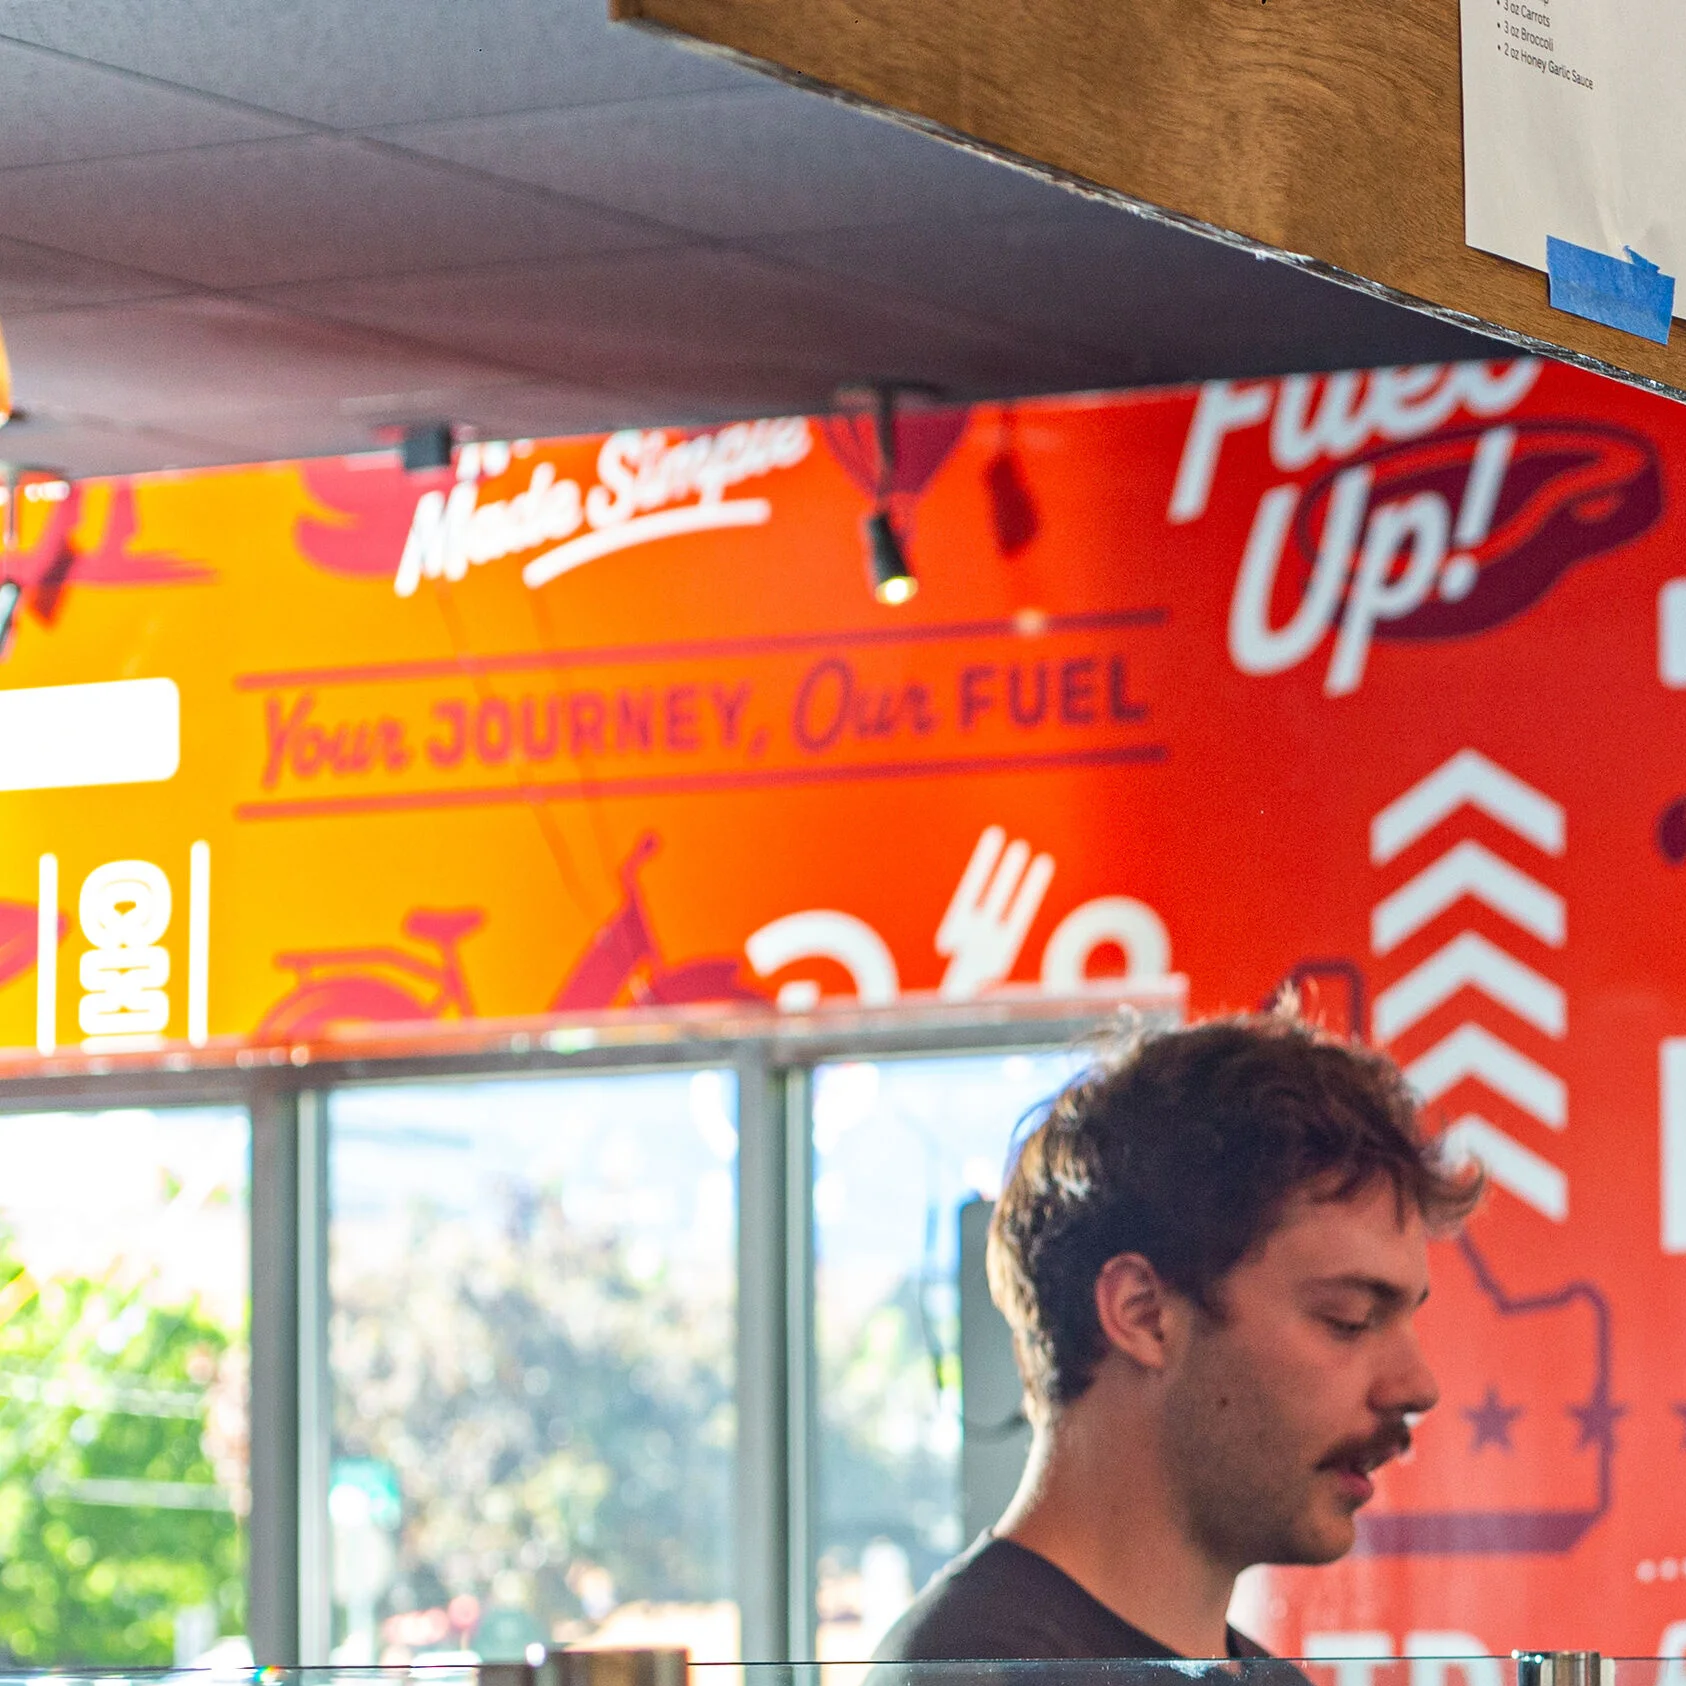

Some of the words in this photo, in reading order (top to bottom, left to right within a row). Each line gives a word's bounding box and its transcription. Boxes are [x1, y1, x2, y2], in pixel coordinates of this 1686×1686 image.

[1504, 20, 1509, 35] 3
[1510, 26, 1519, 39] oz
[1521, 28, 1554, 52] Broccoli
[1510, 3, 1519, 15] oz
[1520, 4, 1551, 28] Carrots
[1504, 42, 1509, 57] 2
[1510, 48, 1519, 61] oz
[1521, 51, 1547, 73] Honey
[1548, 60, 1570, 80] Garlic
[1572, 70, 1594, 90] Sauce
[394, 462, 583, 598] Made
[1226, 424, 1518, 699] Up!
[262, 690, 410, 791] Your
[791, 656, 935, 754] Our
[957, 654, 1151, 732] FUEL
